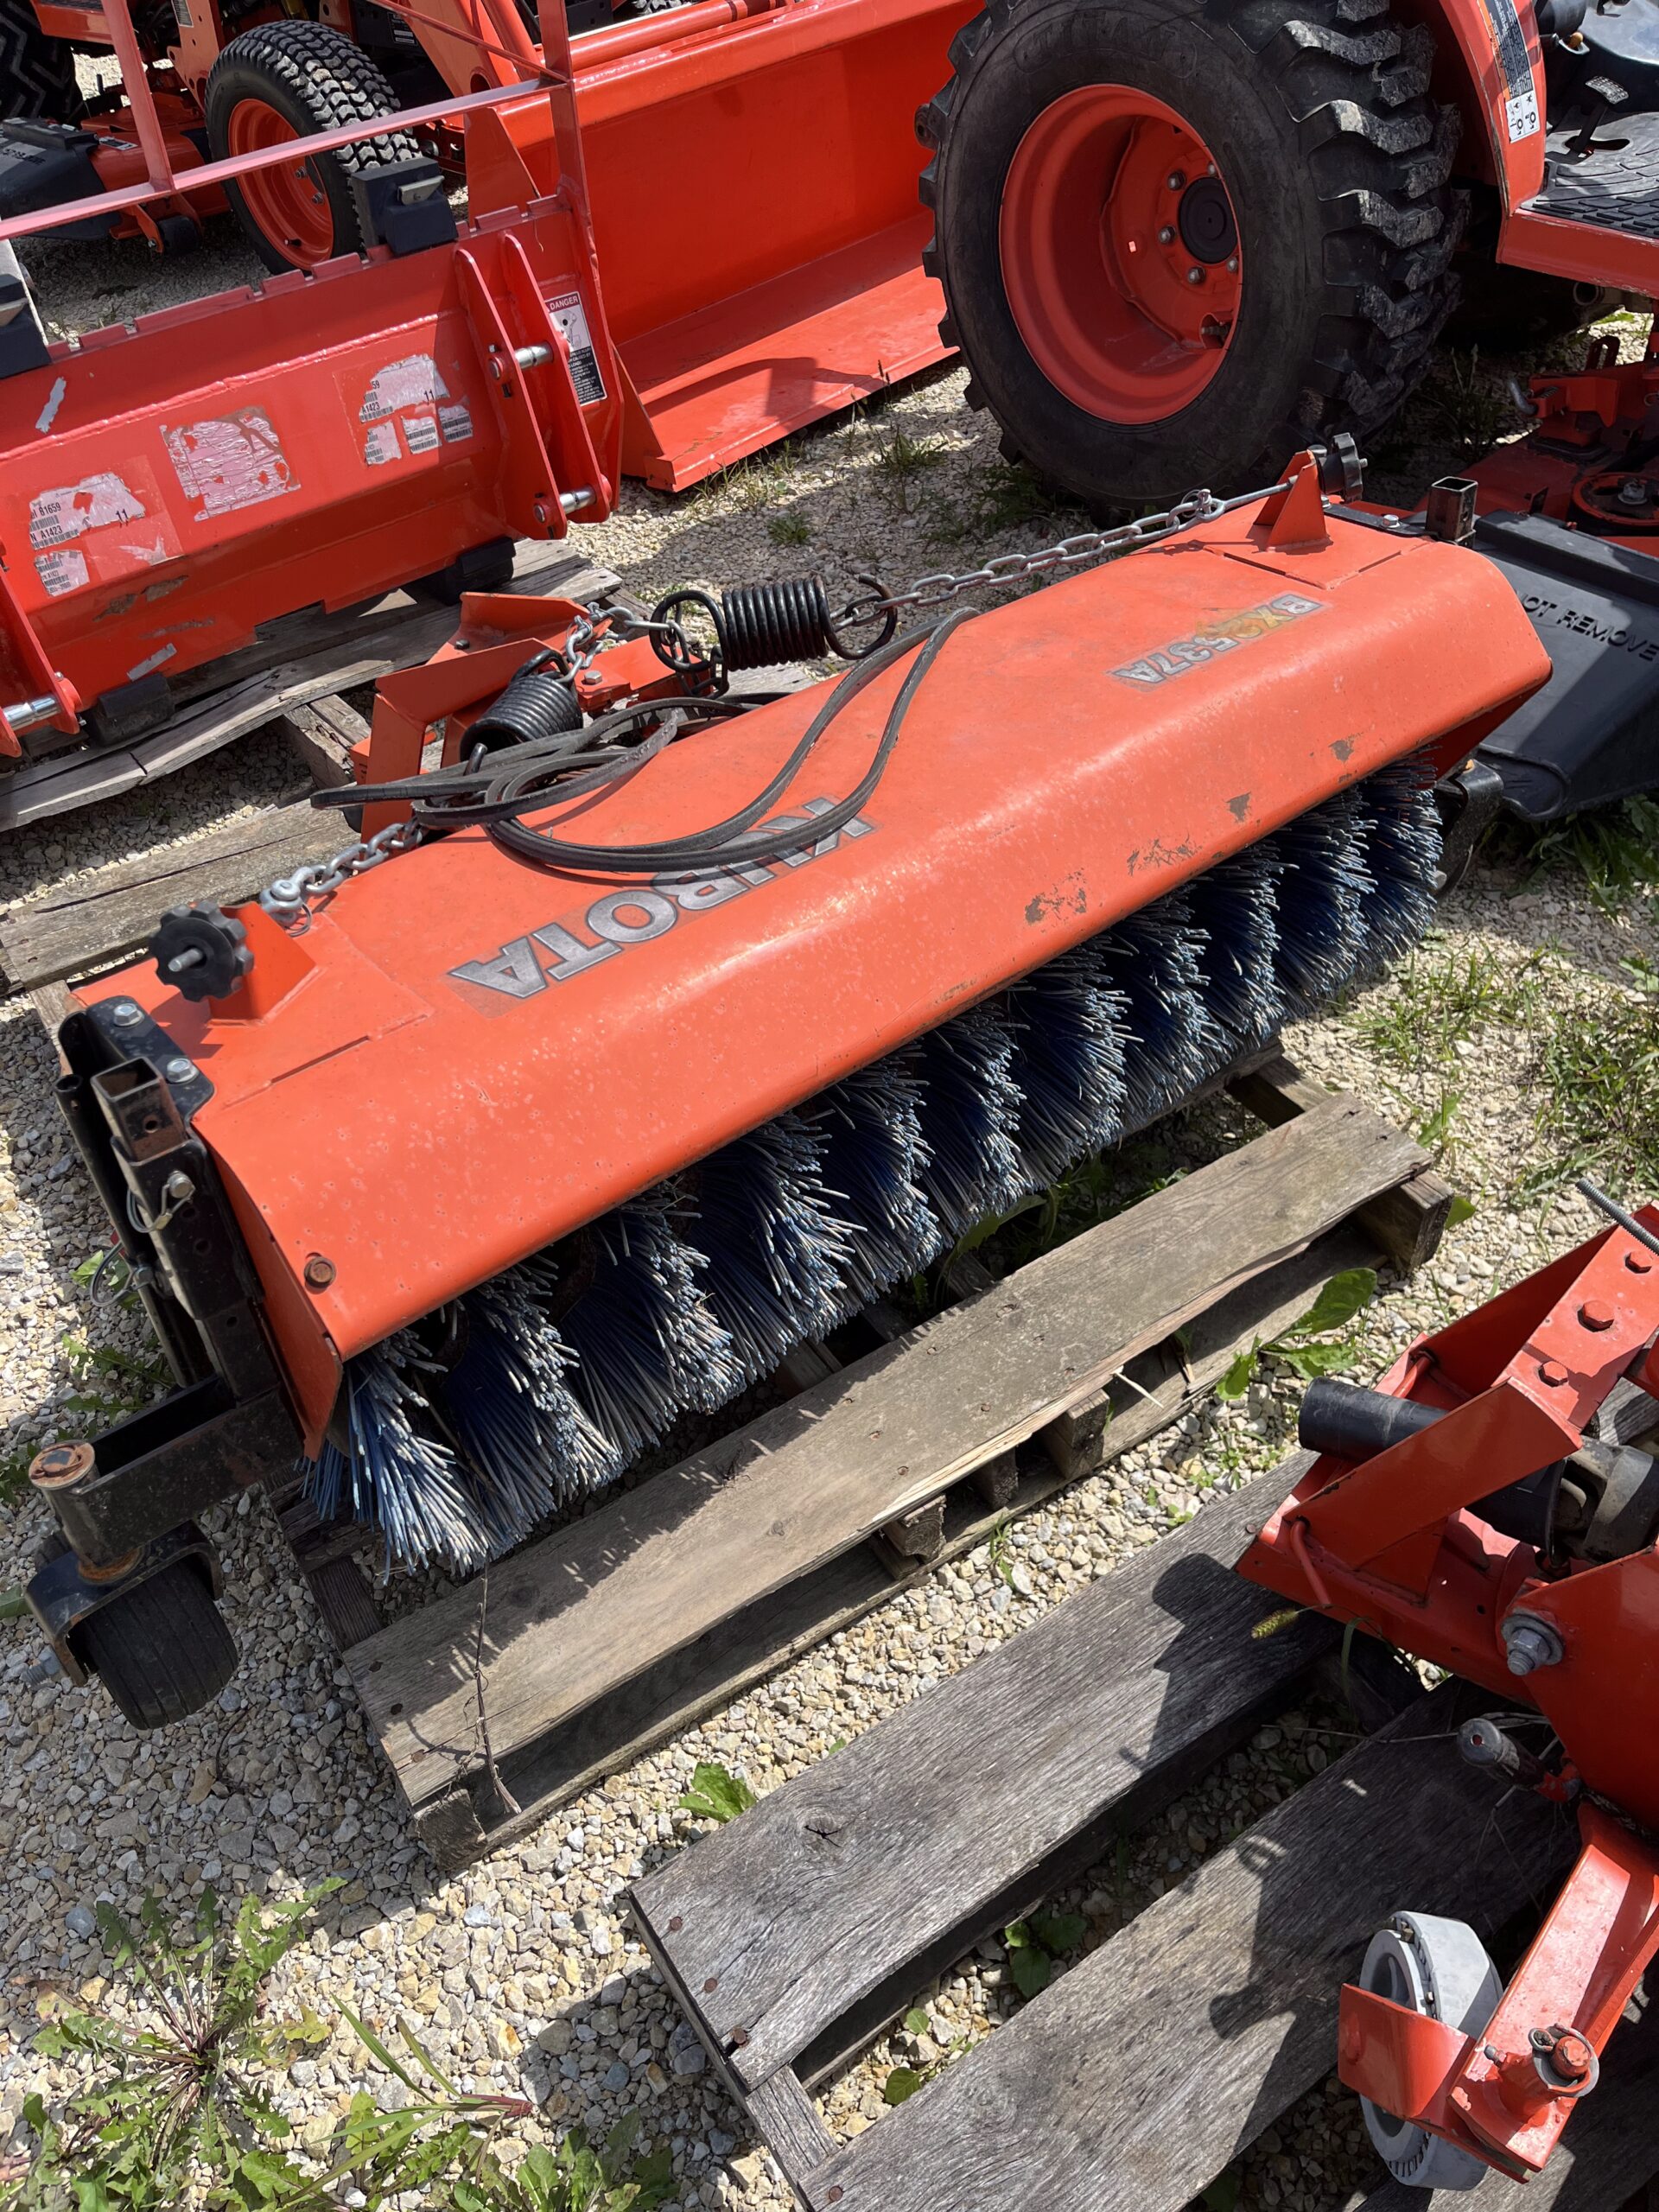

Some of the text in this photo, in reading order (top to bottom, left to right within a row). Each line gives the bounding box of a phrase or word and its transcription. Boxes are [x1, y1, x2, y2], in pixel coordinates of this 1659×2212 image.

[550, 296, 579, 311] DANGER
[41, 524, 63, 539] A1423
[1112, 594, 1323, 683] BX2537A
[1556, 608, 1659, 663] REMOVE
[447, 795, 876, 1000] KUBOTA
